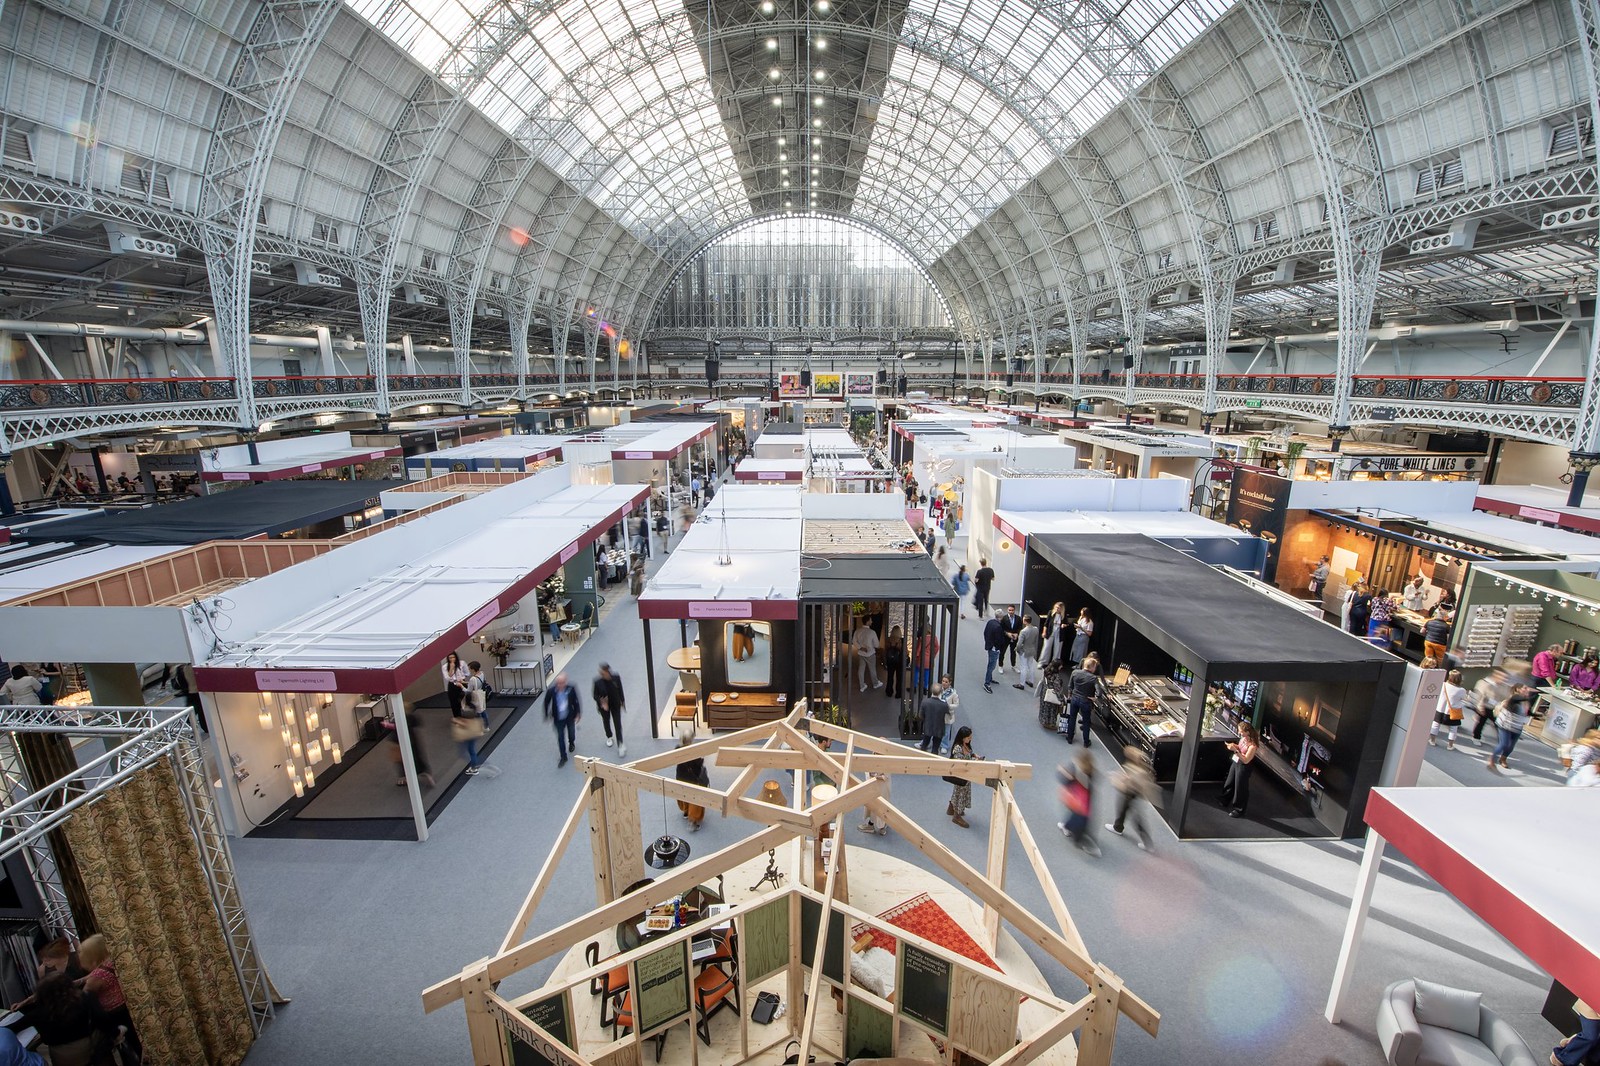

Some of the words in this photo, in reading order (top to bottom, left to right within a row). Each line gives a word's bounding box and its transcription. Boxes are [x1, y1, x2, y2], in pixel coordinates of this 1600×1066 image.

[1380, 458, 1399, 470] PURE
[1403, 458, 1429, 470] WHITE
[1432, 458, 1456, 470] LINES
[1247, 491, 1264, 500] cocktail
[1264, 494, 1275, 502] hour
[497, 1006, 540, 1051] Think
[543, 1043, 572, 1066] Cir
